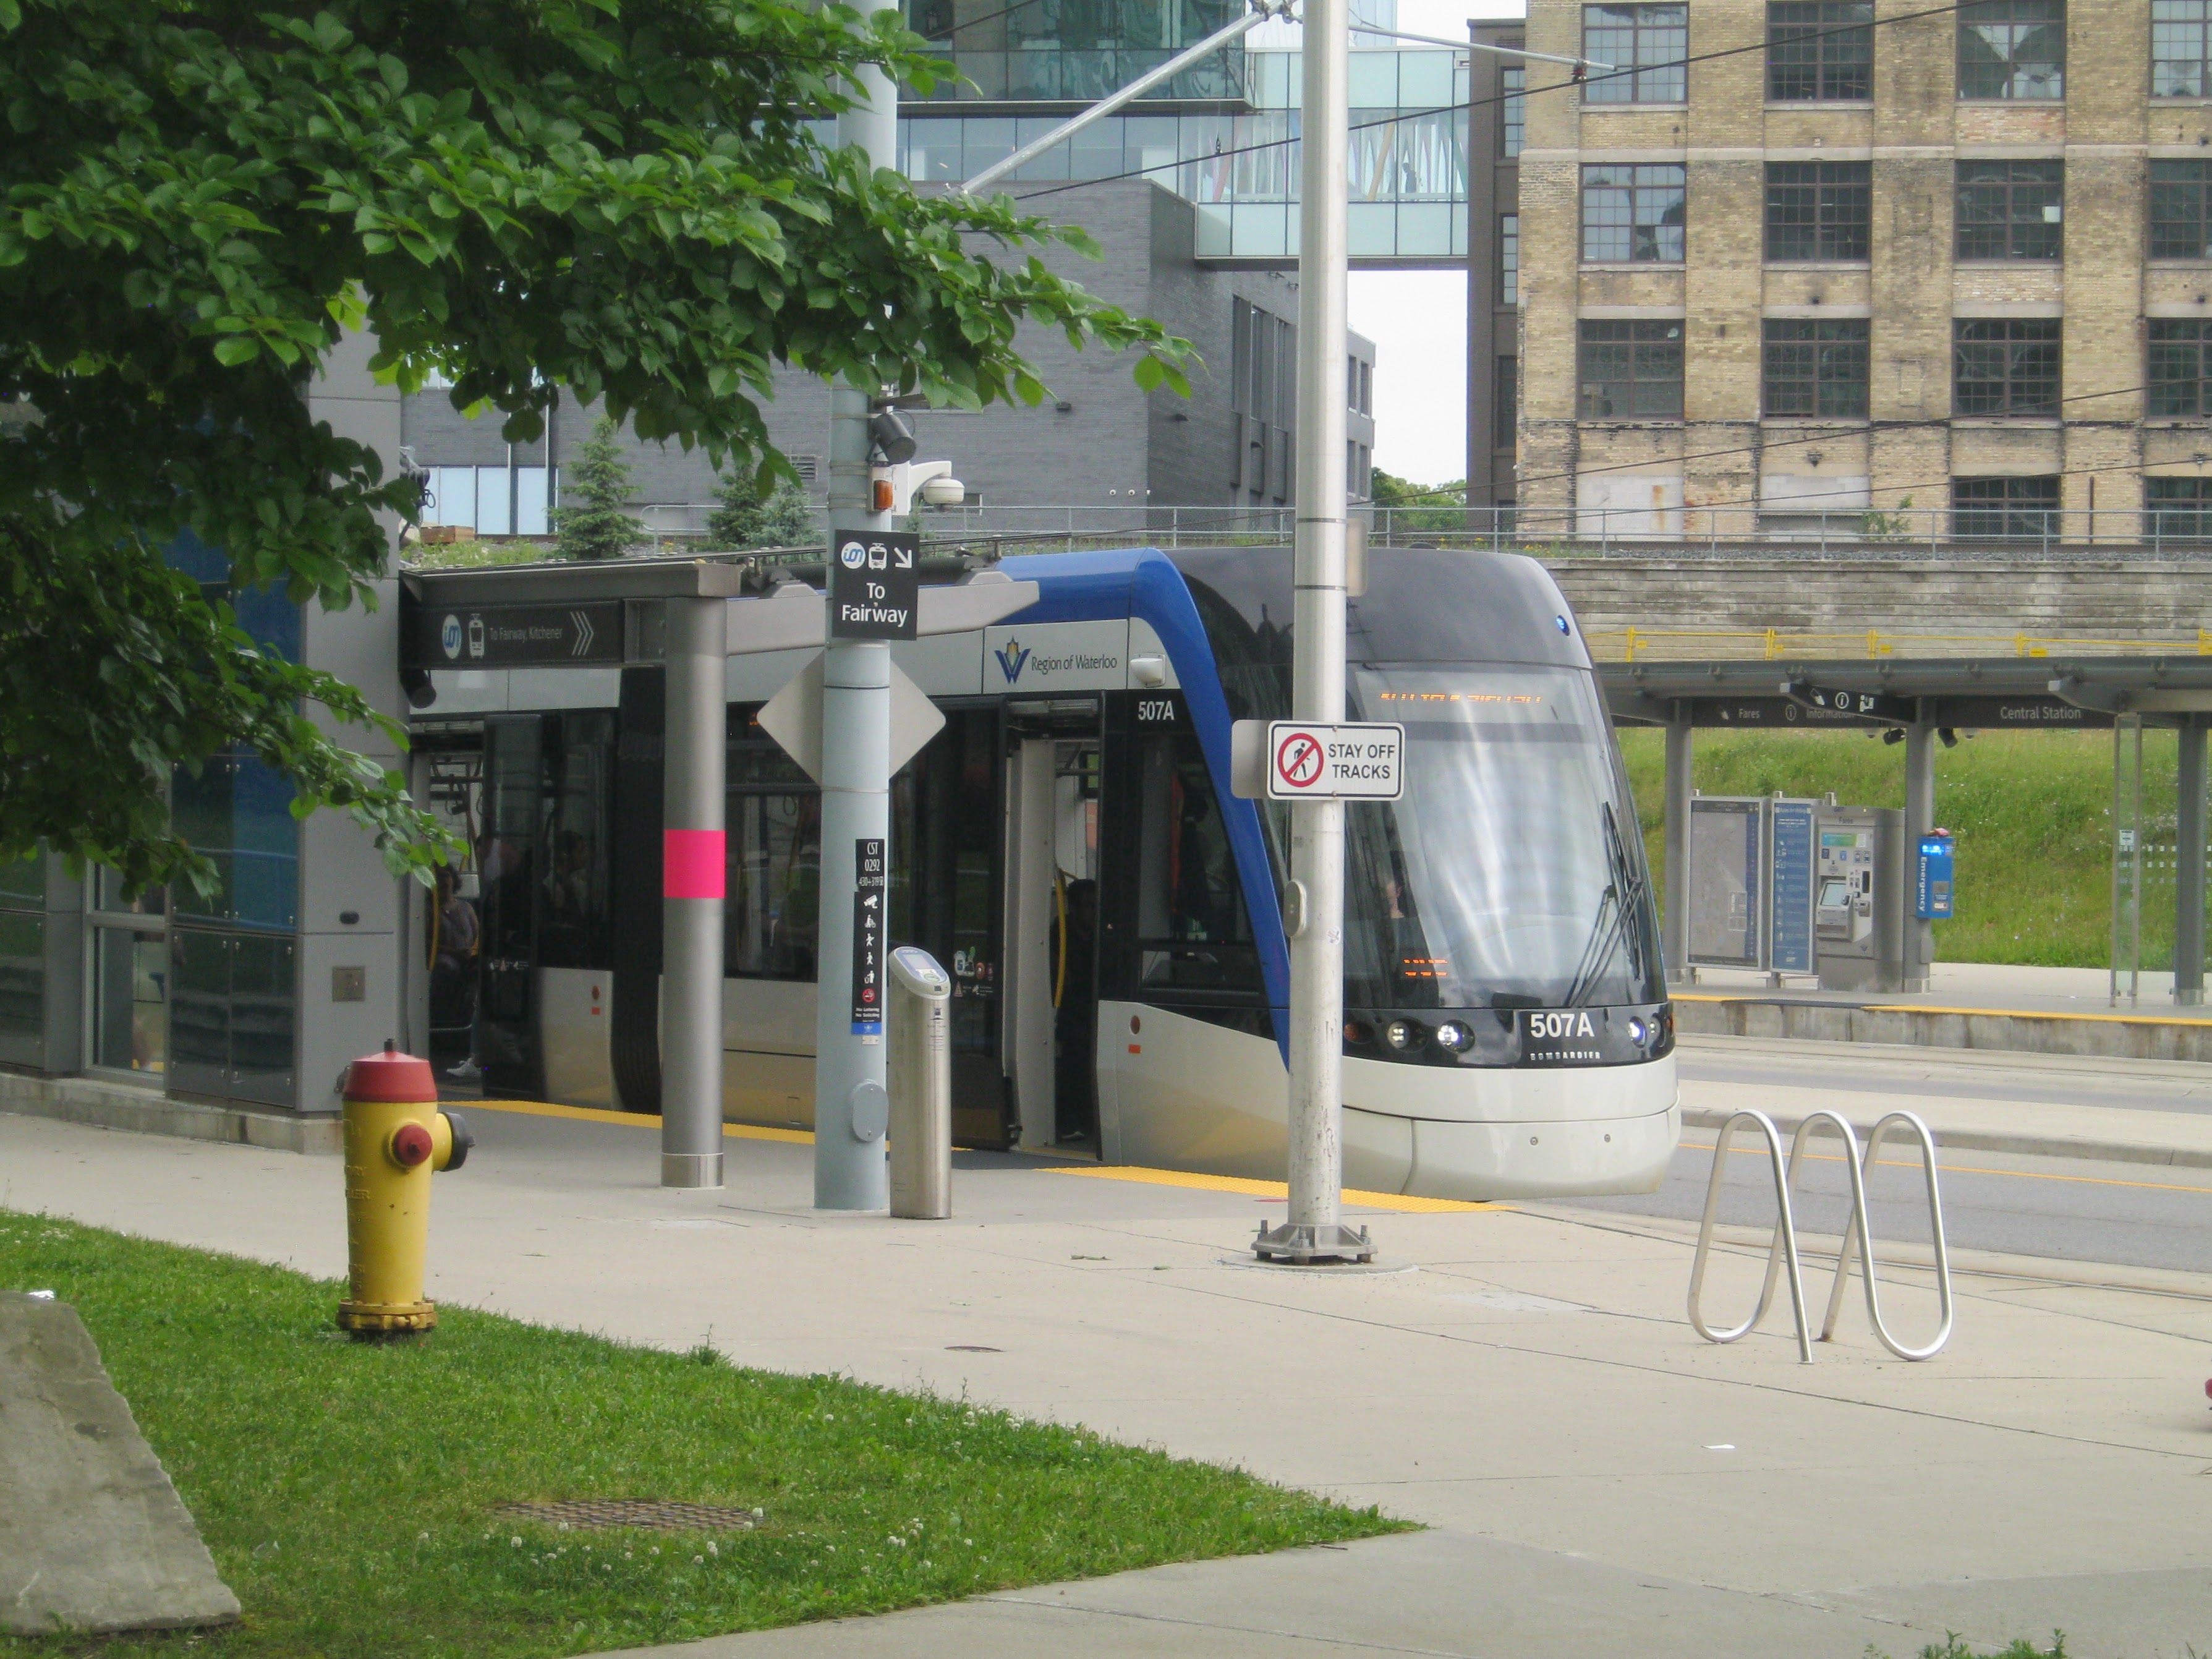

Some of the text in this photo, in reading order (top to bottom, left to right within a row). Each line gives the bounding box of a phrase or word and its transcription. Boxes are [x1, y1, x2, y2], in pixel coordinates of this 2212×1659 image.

[867, 582, 885, 599] To
[841, 604, 908, 628] Fairway
[490, 625, 563, 643] To Fairway, Kitchener
[1031, 654, 1117, 675] Region of Waterloo
[1138, 701, 1175, 720] 507A
[1738, 708, 1760, 719] Fares
[2000, 706, 2082, 719] Central Station
[1328, 744, 1395, 758] STAY OFF
[1332, 764, 1390, 779] TRACKS
[867, 842, 878, 855] CST
[864, 859, 880, 871] 0292
[1918, 856, 1927, 912] Emergency
[1530, 1012, 1595, 1038] 507A
[1529, 1051, 1601, 1061] BOMBARDIER
